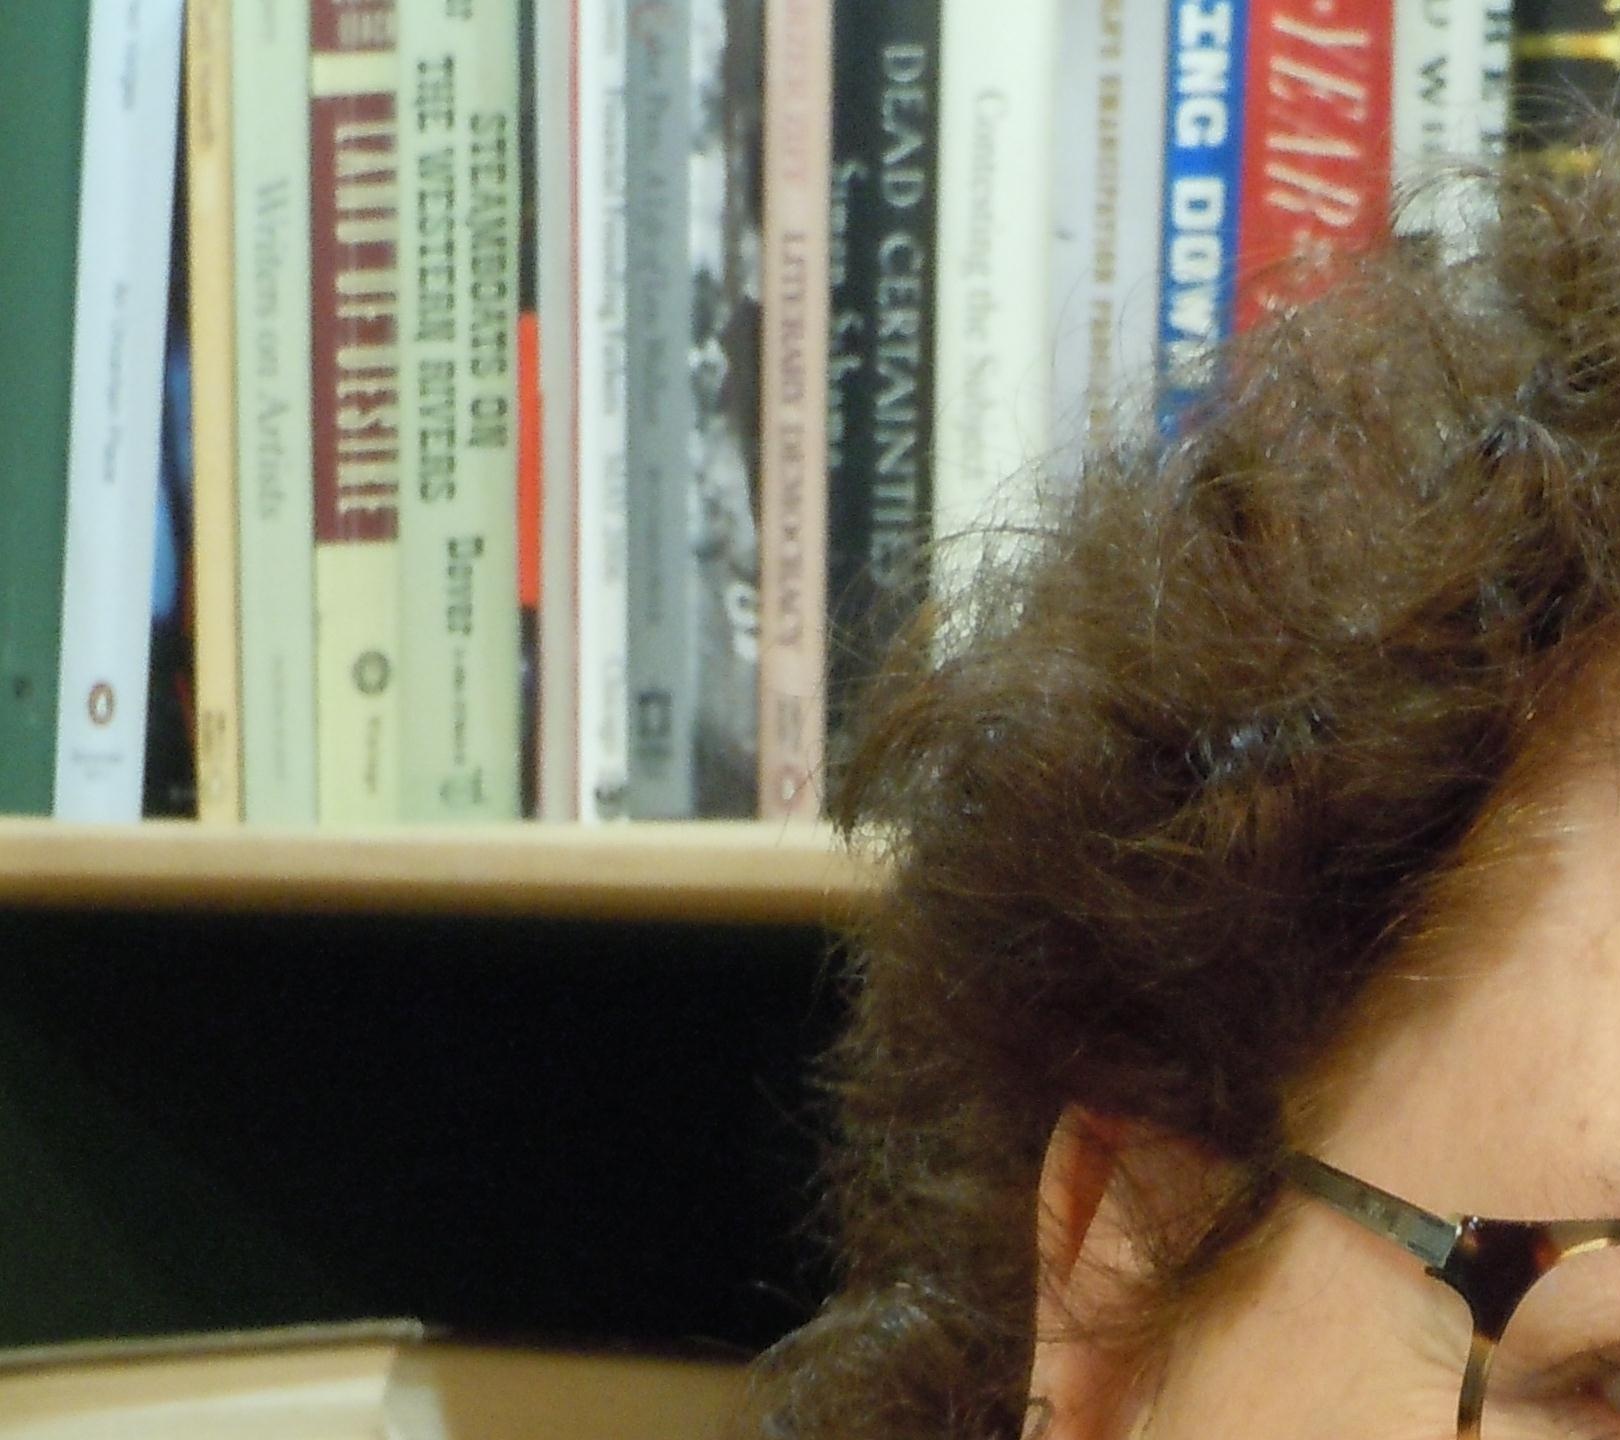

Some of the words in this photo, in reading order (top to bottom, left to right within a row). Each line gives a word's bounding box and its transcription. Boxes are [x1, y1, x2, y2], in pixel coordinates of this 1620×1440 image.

[413, 56, 455, 133] THE
[880, 40, 926, 210] DEAD
[1264, 12, 1373, 228] YEAR
[255, 175, 291, 319] Writers
[413, 147, 455, 343] WESTERN
[468, 112, 508, 377] STEAMBOATS
[963, 87, 1011, 278] Contesting
[256, 326, 281, 377] on
[778, 230, 808, 406] LITERARY
[963, 287, 1001, 344] the
[257, 391, 291, 521] Artists
[413, 359, 455, 504] RIVERS
[470, 397, 508, 449] ON
[869, 231, 925, 588] CERTAINTIES
[956, 353, 1000, 484] Subject
[447, 536, 485, 636] Dover
[772, 421, 805, 651] DEMOCRACY
